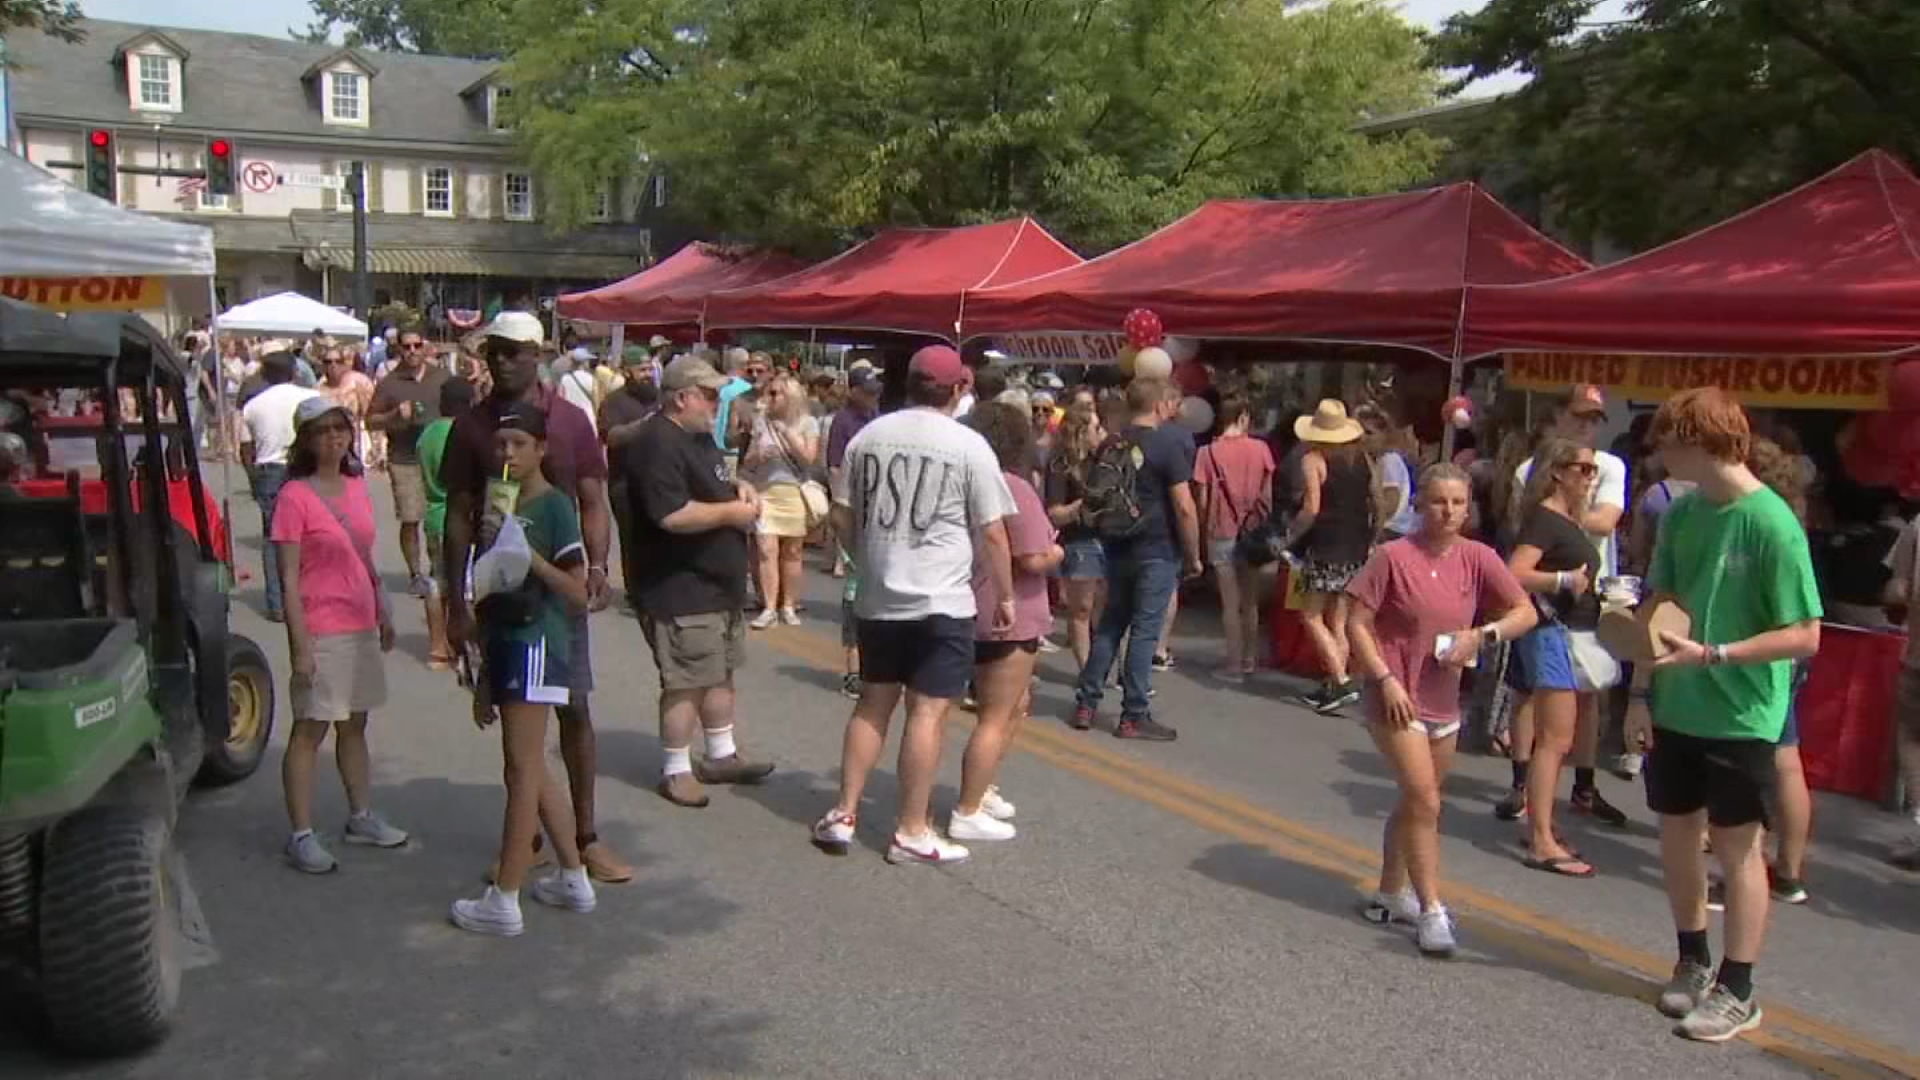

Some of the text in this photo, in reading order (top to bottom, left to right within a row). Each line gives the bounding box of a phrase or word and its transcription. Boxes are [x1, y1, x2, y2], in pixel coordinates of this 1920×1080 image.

[1511, 354, 1879, 395] PAINTED MUSHROOMS
[862, 451, 953, 532] PSU
